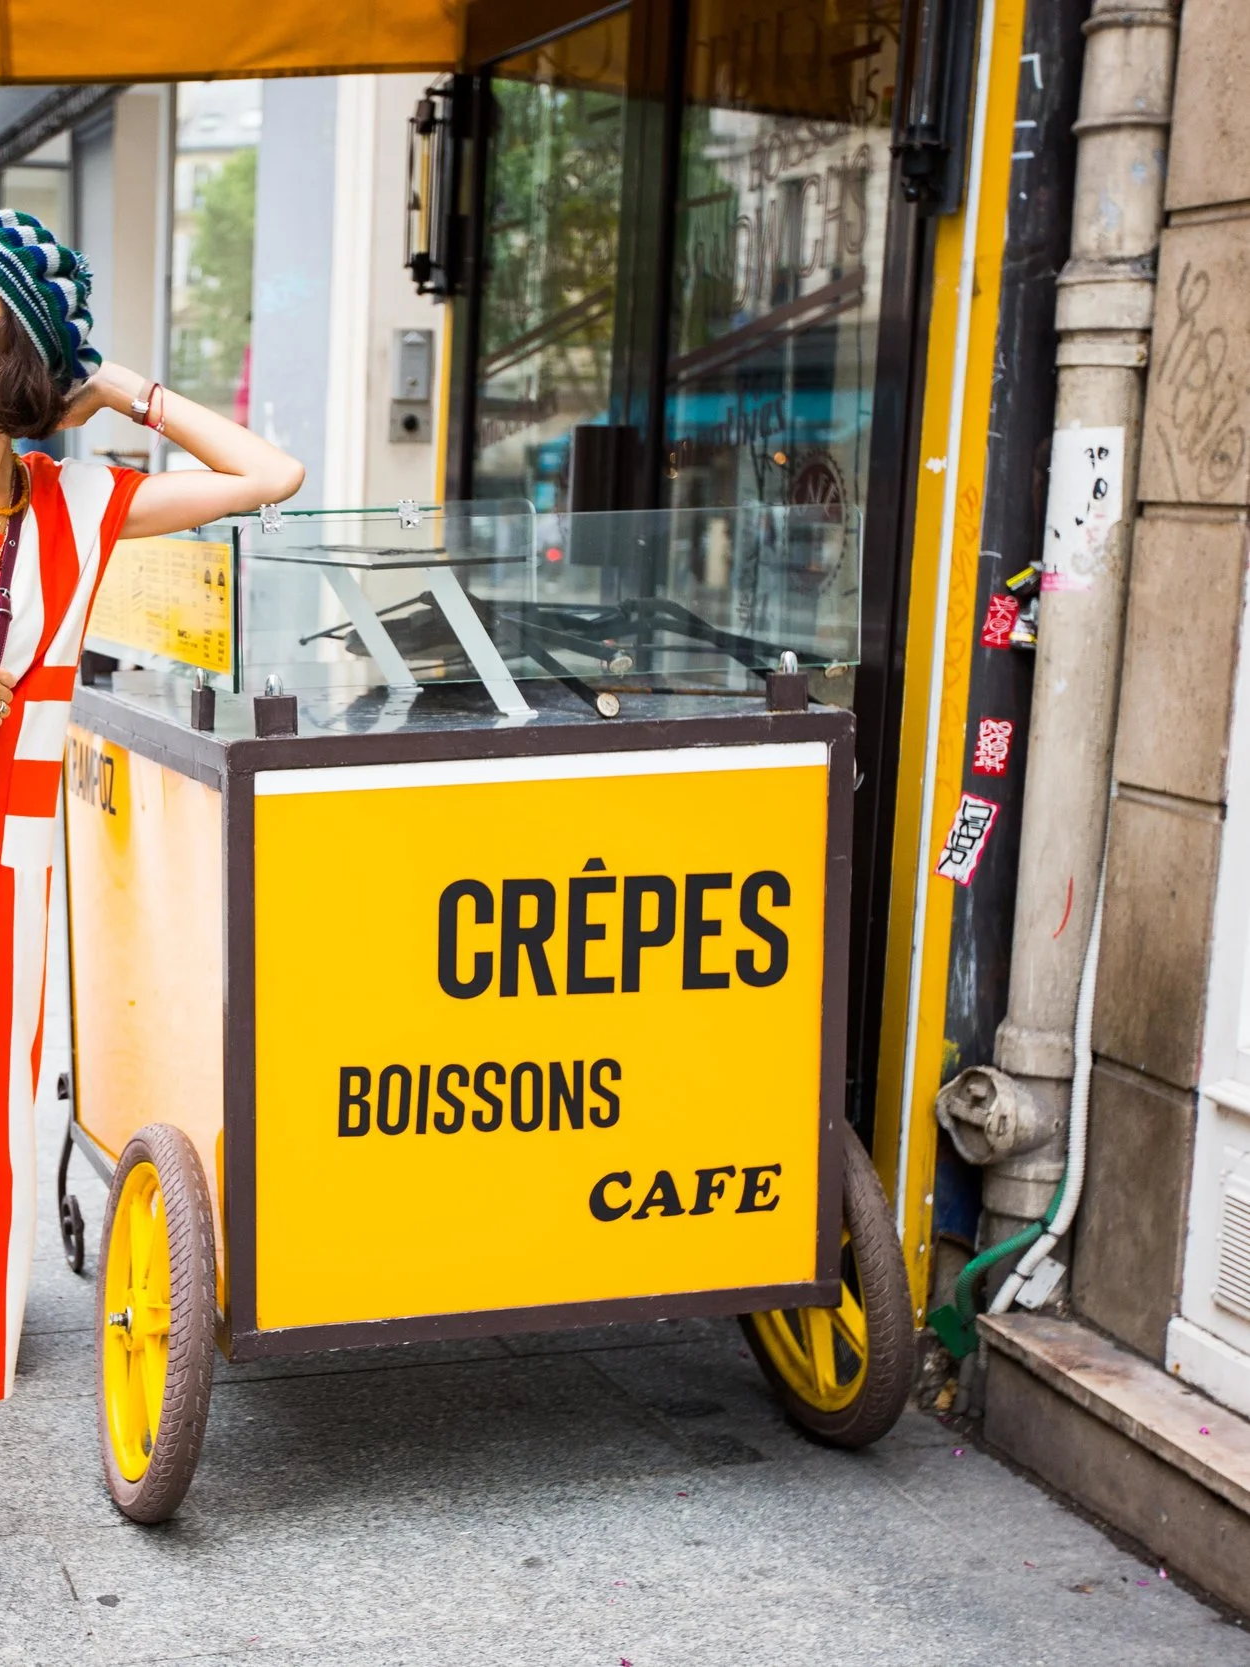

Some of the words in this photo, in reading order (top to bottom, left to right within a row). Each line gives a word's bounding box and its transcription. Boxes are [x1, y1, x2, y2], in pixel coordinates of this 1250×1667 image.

[438, 858, 790, 999] CRÊPES
[339, 1059, 621, 1136] BOISSONS
[590, 1164, 781, 1221] CAFE
